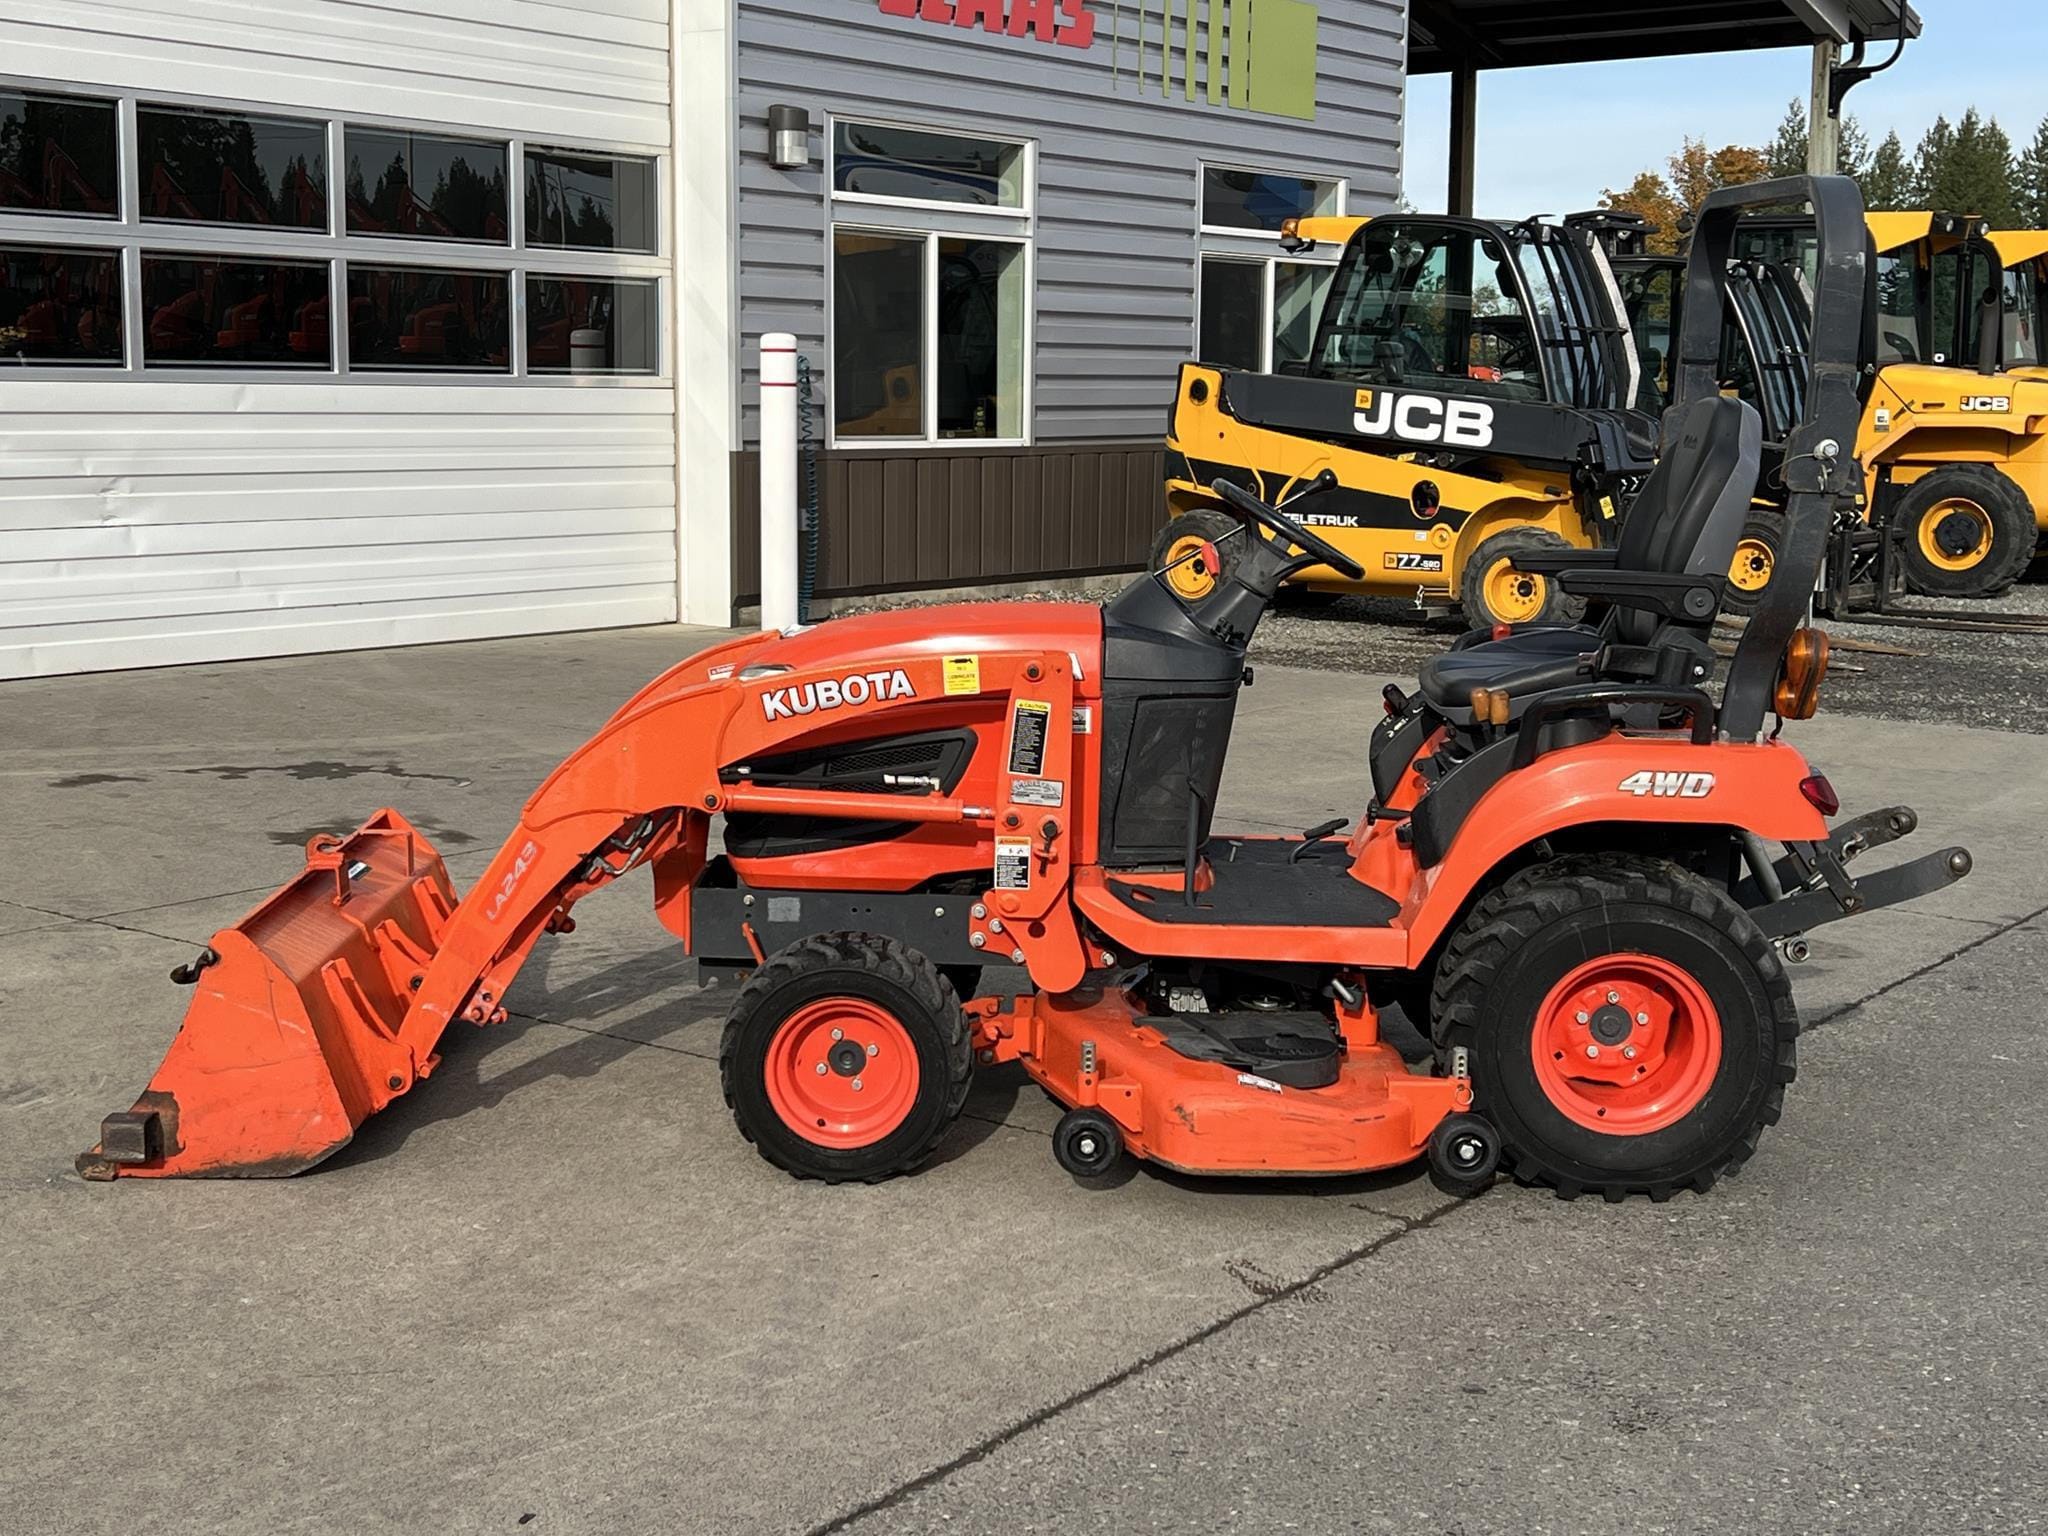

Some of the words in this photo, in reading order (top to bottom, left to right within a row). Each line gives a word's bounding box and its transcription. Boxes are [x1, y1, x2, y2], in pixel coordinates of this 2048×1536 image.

[1354, 391, 1494, 447] JCB
[1961, 397, 2009, 411] JCB
[763, 669, 916, 721] KUBOTA
[1618, 771, 1716, 797] 4WD
